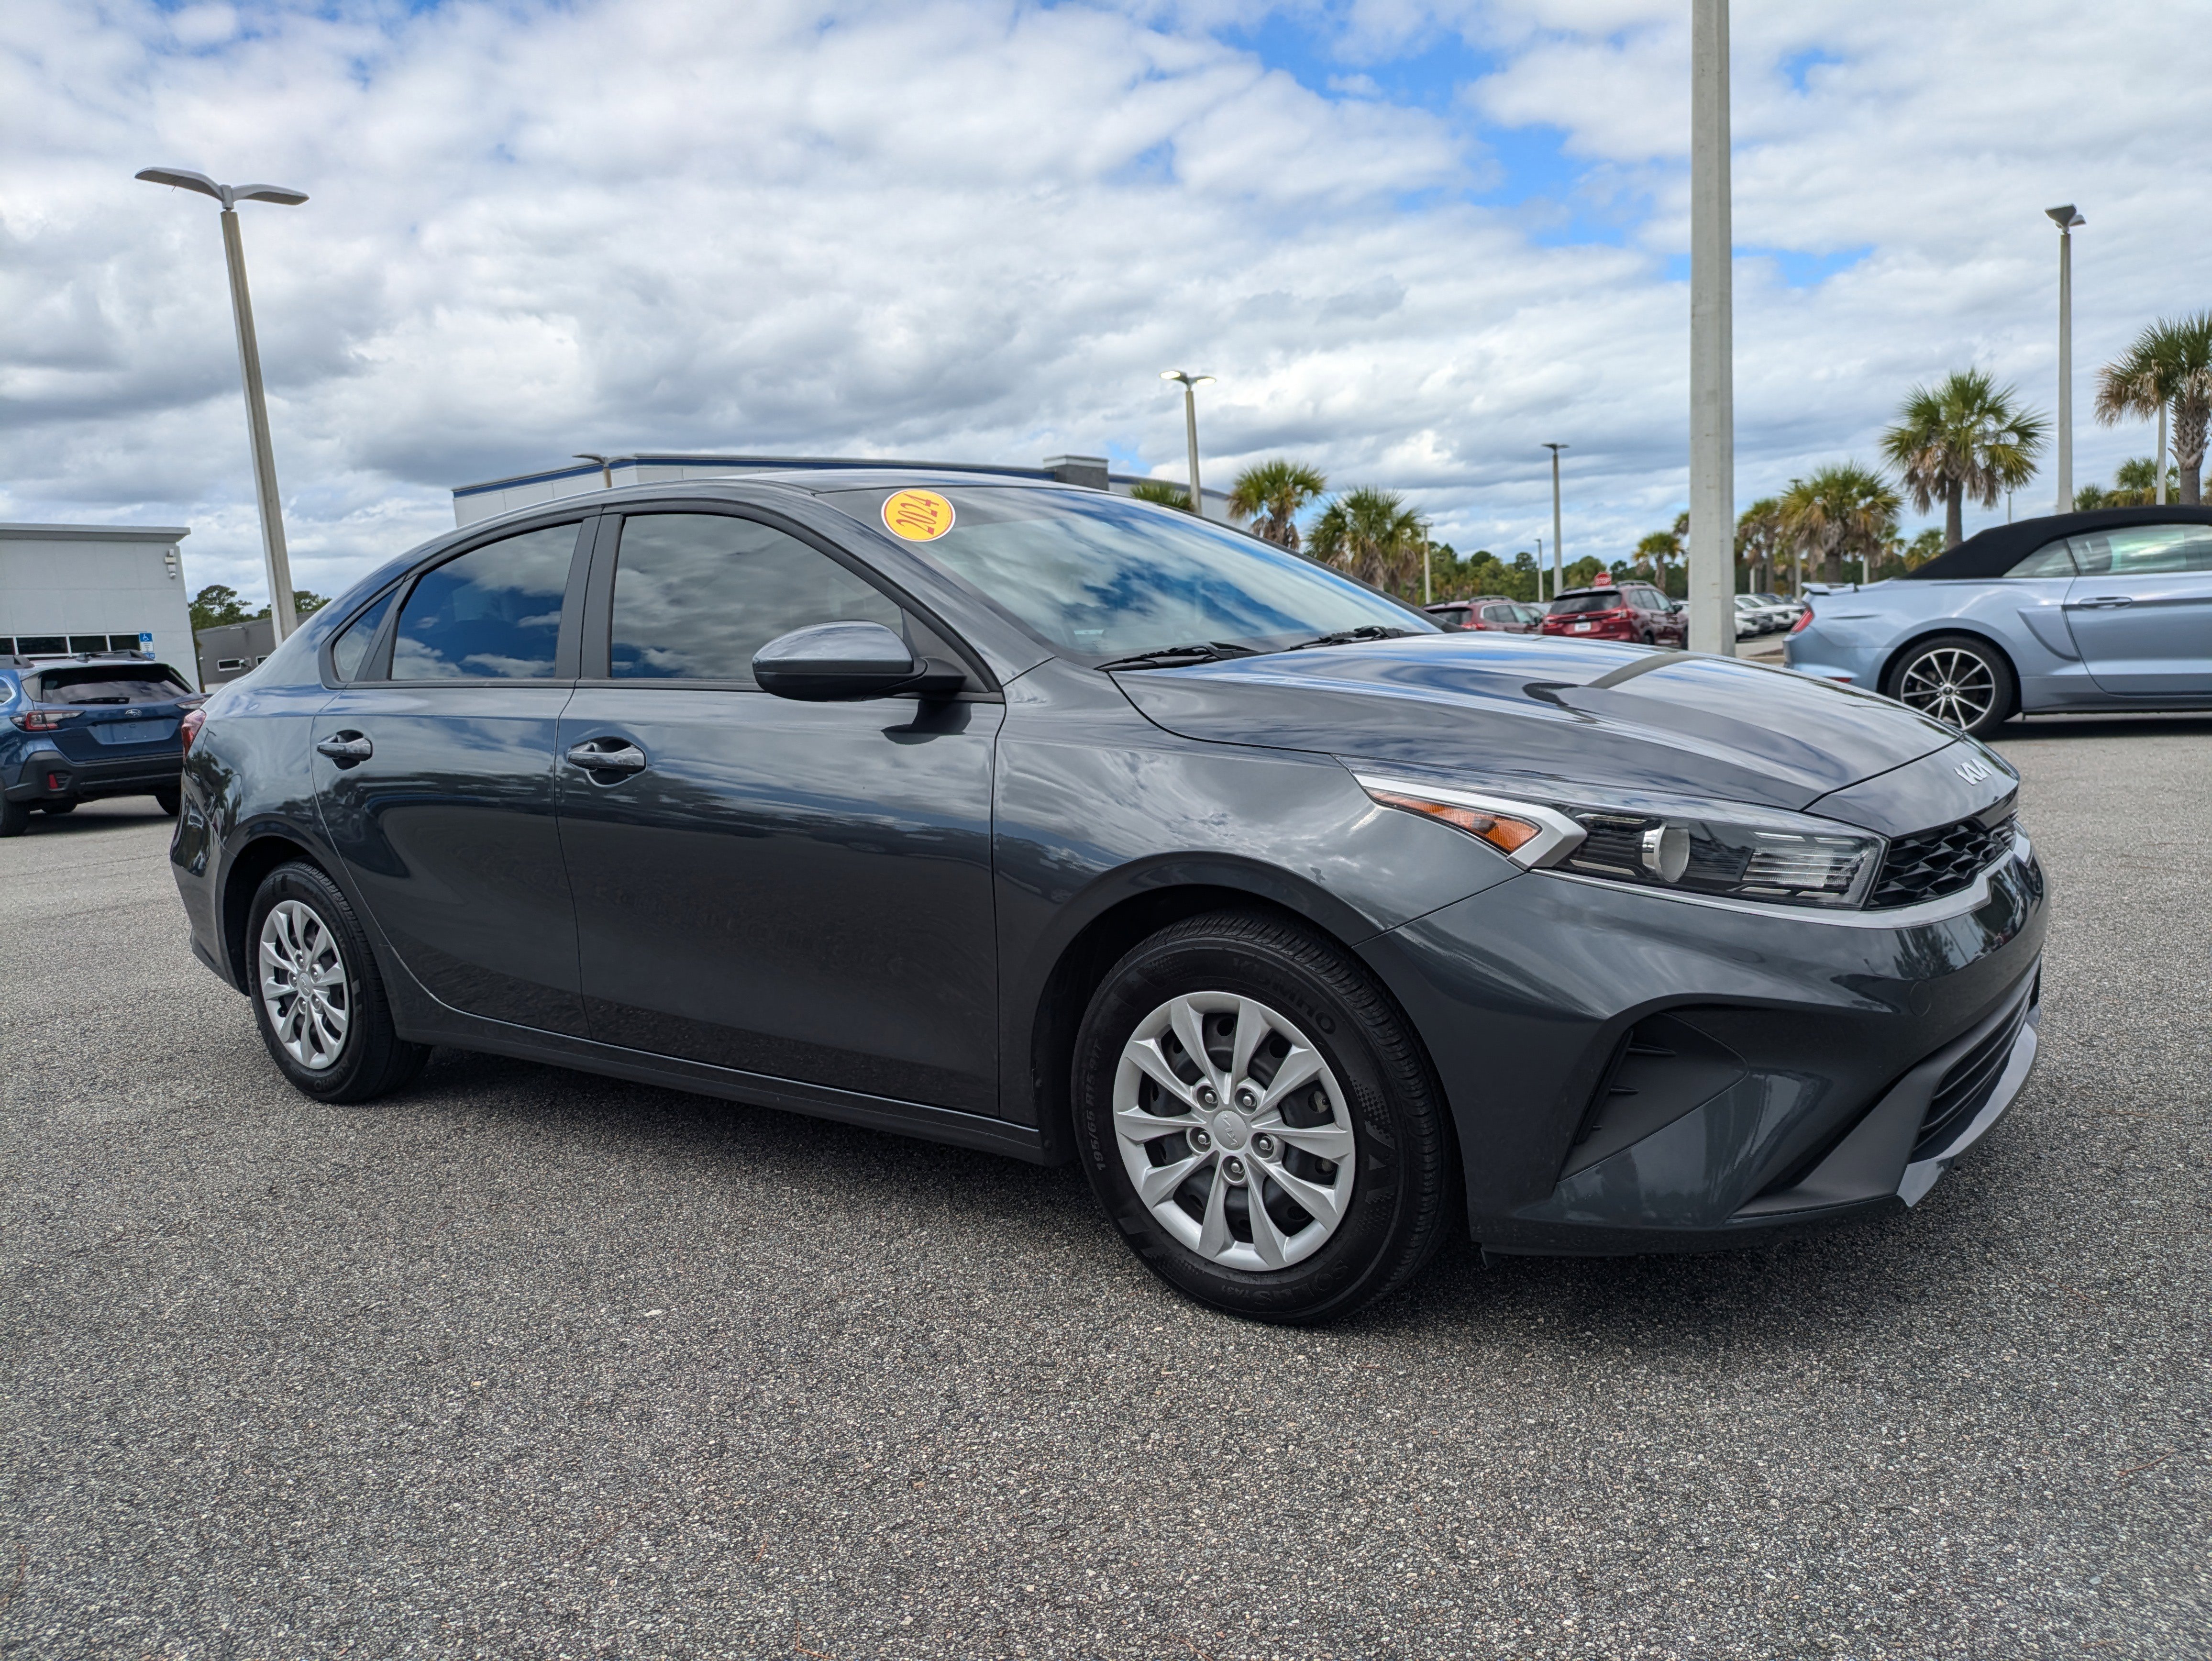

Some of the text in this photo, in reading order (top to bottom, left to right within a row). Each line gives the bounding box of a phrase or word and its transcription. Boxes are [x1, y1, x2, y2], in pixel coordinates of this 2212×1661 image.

[896, 492, 940, 535] 2024
[1953, 758, 1992, 786] KIA
[1233, 957, 1336, 1034] KUMHO
[1086, 1109, 1106, 1171] 195/65
